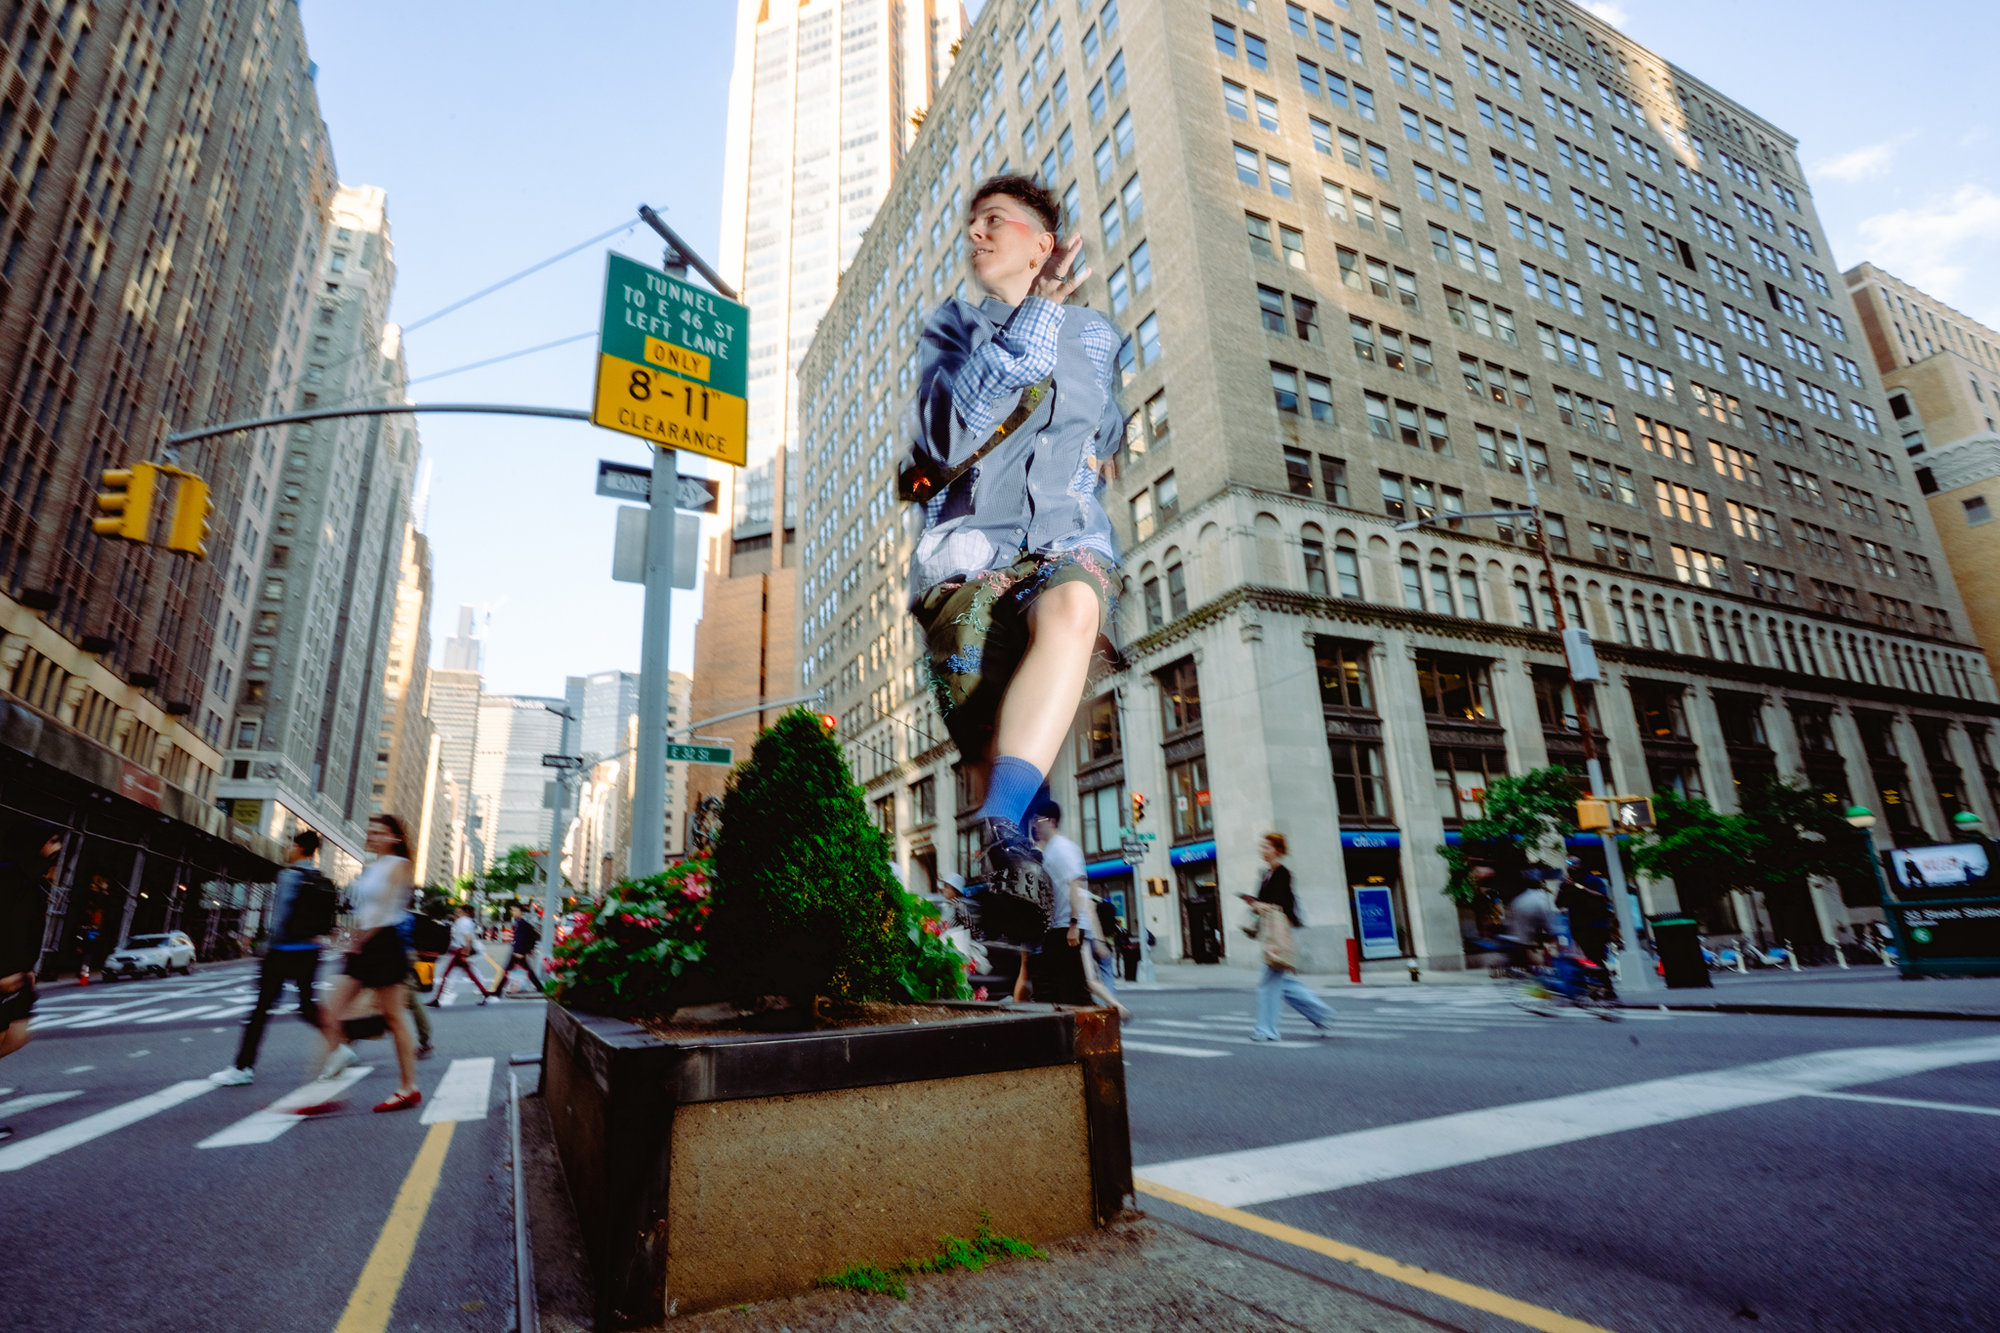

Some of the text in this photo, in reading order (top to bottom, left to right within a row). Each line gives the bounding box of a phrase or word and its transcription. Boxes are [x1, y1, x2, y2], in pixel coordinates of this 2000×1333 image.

[623, 284, 735, 342] TO E 46 ST
[645, 272, 718, 317] TUNNEL
[625, 307, 728, 360] LEFT LANE
[654, 343, 702, 373] ONLY
[618, 407, 727, 454] CLEARANCE
[671, 747, 679, 758] E
[1352, 833, 1388, 848] citibank
